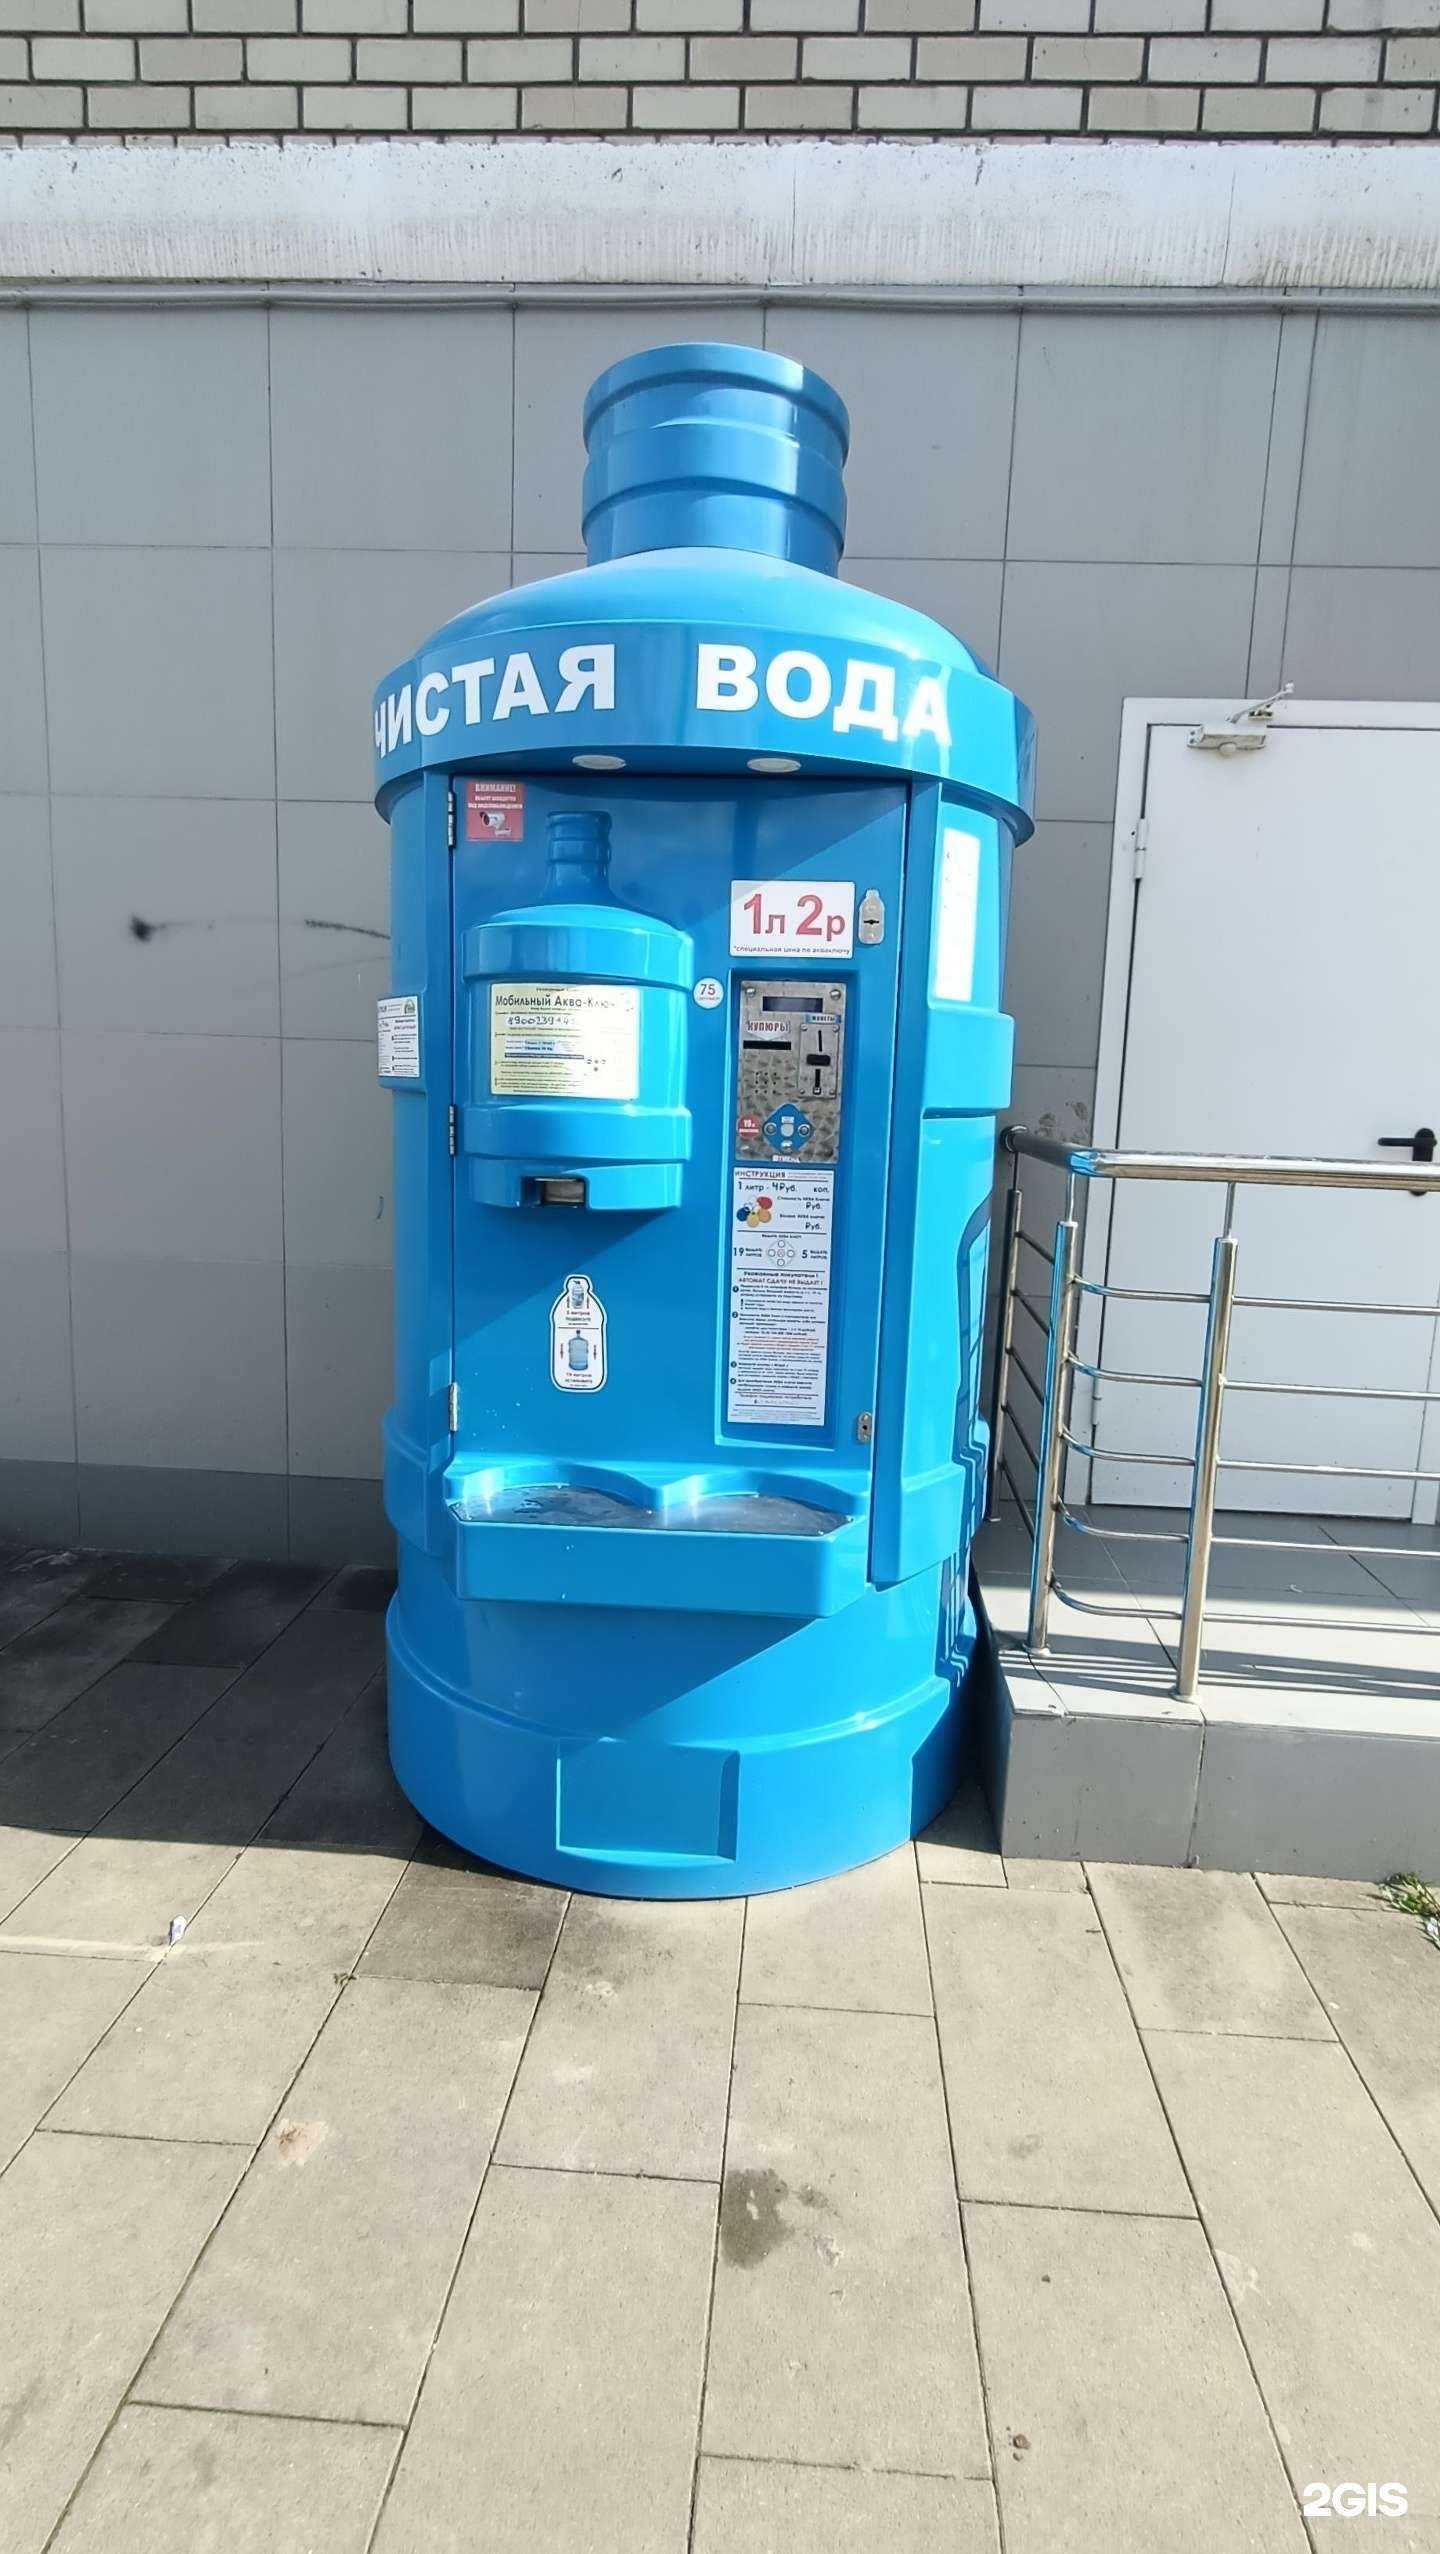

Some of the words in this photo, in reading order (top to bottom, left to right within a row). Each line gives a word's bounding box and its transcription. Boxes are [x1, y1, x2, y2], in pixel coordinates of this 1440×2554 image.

[375, 644, 616, 759] ЧИСТАЯ
[696, 643, 952, 747] ВОДА
[700, 983, 716, 996] 75
[495, 994, 551, 1007] Мобильный
[747, 1021, 789, 1033] КУПЮРЫ
[734, 1170, 786, 1179] ИНСТРУКЦИЯ
[738, 1181, 743, 1190] 1
[745, 1184, 764, 1192] литр
[733, 1246, 745, 1257] 19
[801, 1249, 808, 1259] 5
